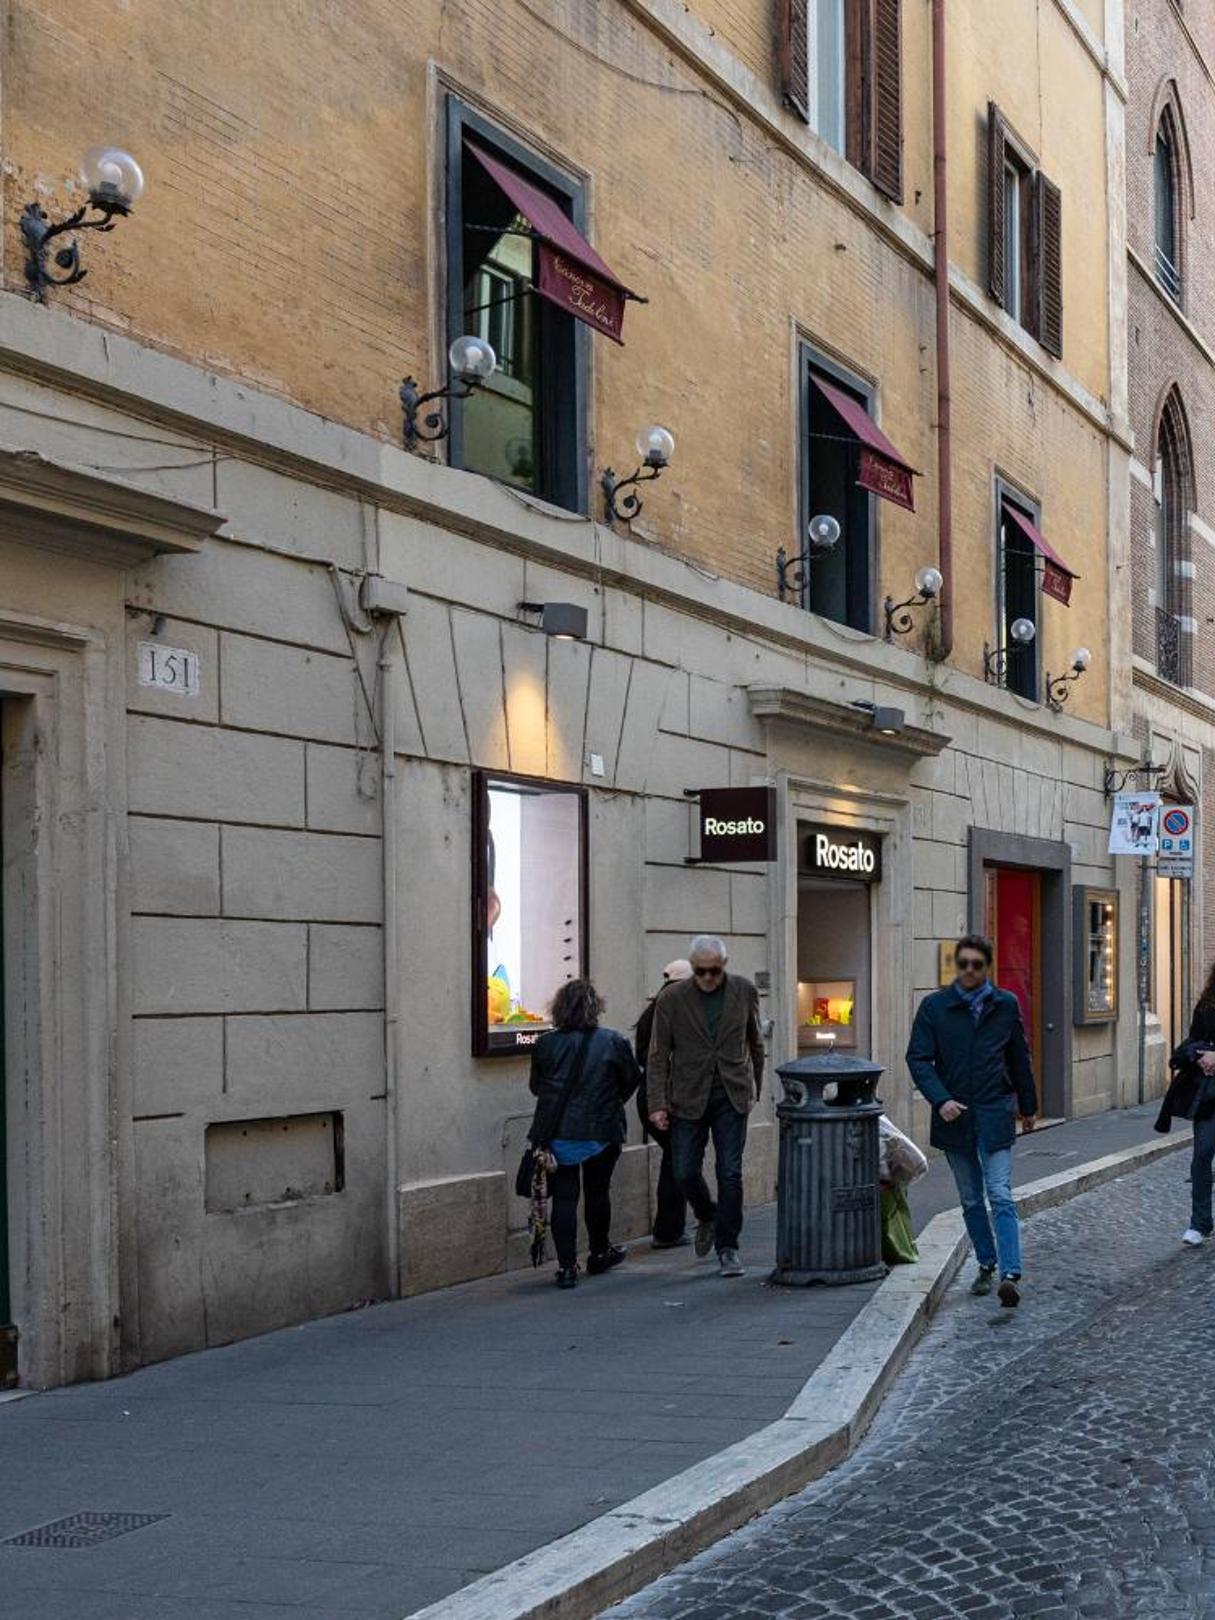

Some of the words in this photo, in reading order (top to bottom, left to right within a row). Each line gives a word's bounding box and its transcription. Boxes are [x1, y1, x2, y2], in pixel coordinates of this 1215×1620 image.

[149, 650, 189, 687] 151
[705, 817, 764, 835] Rosato
[816, 834, 874, 872] Rosato
